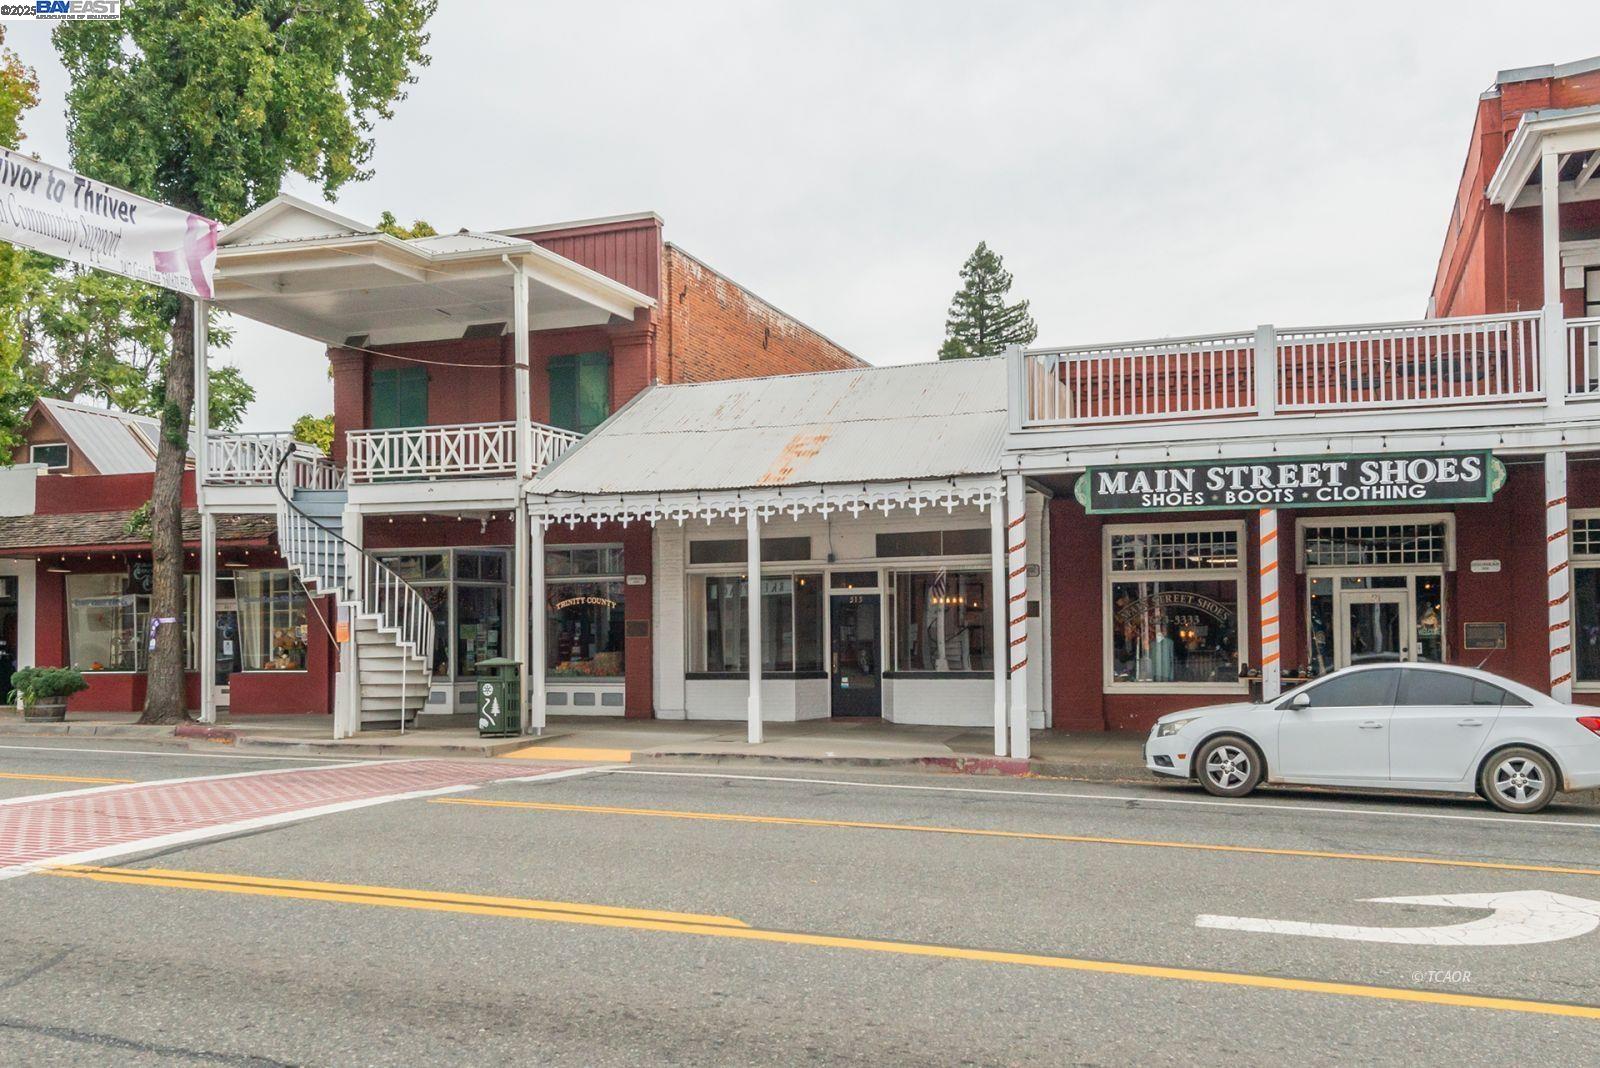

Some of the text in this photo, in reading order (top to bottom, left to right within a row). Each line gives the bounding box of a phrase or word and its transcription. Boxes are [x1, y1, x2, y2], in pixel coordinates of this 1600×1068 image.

[0, 151, 137, 224] ivor to Thriver
[8, 193, 78, 255] Community
[79, 215, 122, 263] Support
[1098, 457, 1482, 495] MAIN STREET SHOES
[1142, 485, 1426, 507] SHOES BOOTS CLOTHING
[555, 597, 617, 610] TRINITY COUNTY
[1197, 597, 1230, 621] SHOES
